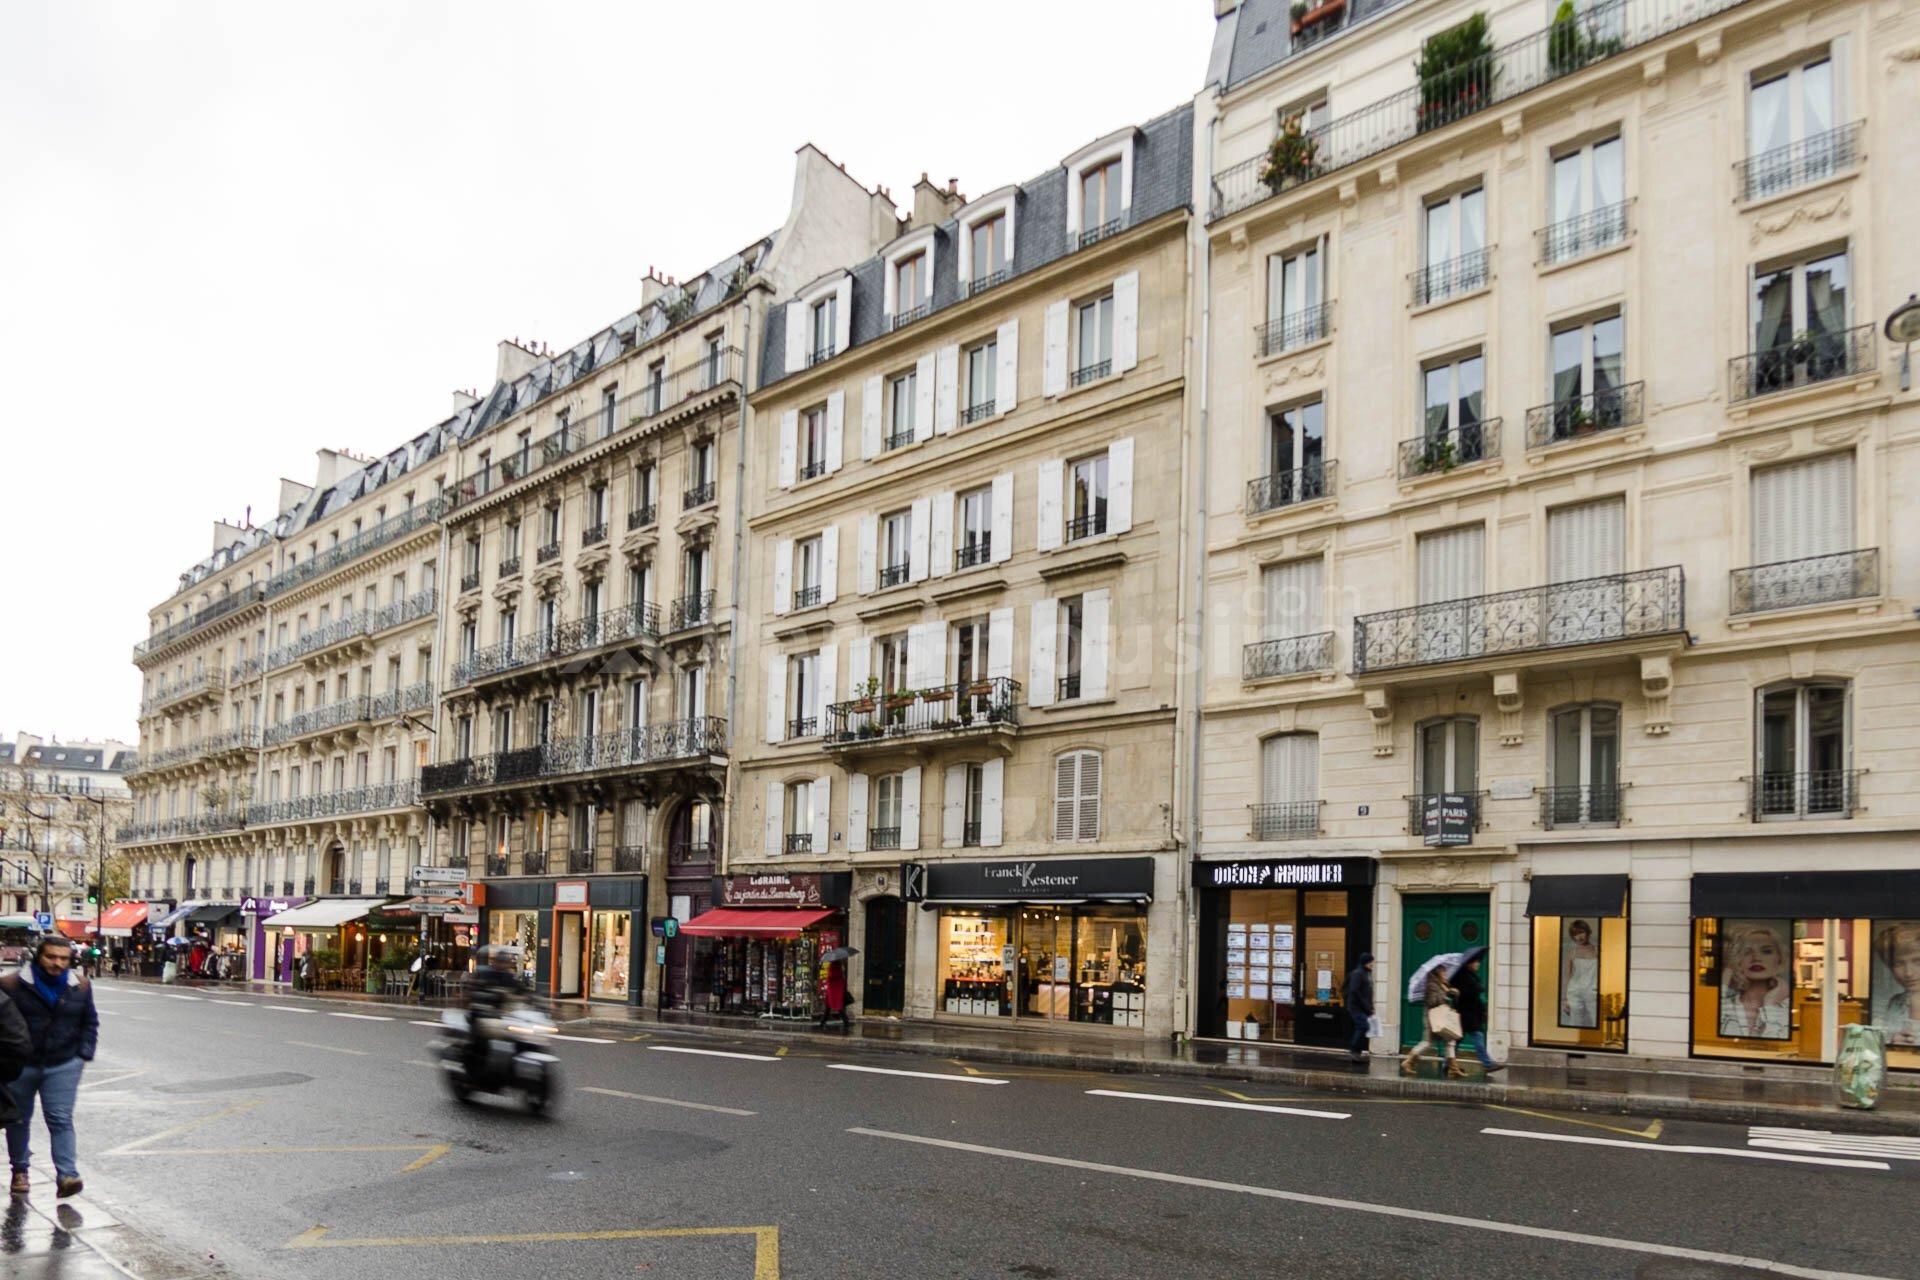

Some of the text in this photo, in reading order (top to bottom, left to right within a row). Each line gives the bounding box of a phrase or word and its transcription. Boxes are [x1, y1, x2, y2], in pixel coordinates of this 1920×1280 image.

[1359, 807, 1367, 816] 9
[1442, 807, 1468, 817] PARIS
[905, 864, 921, 898] K
[984, 862, 1079, 888] Franck Kestener
[1274, 863, 1343, 885] IMMOBILIER
[39, 915, 49, 925] P
